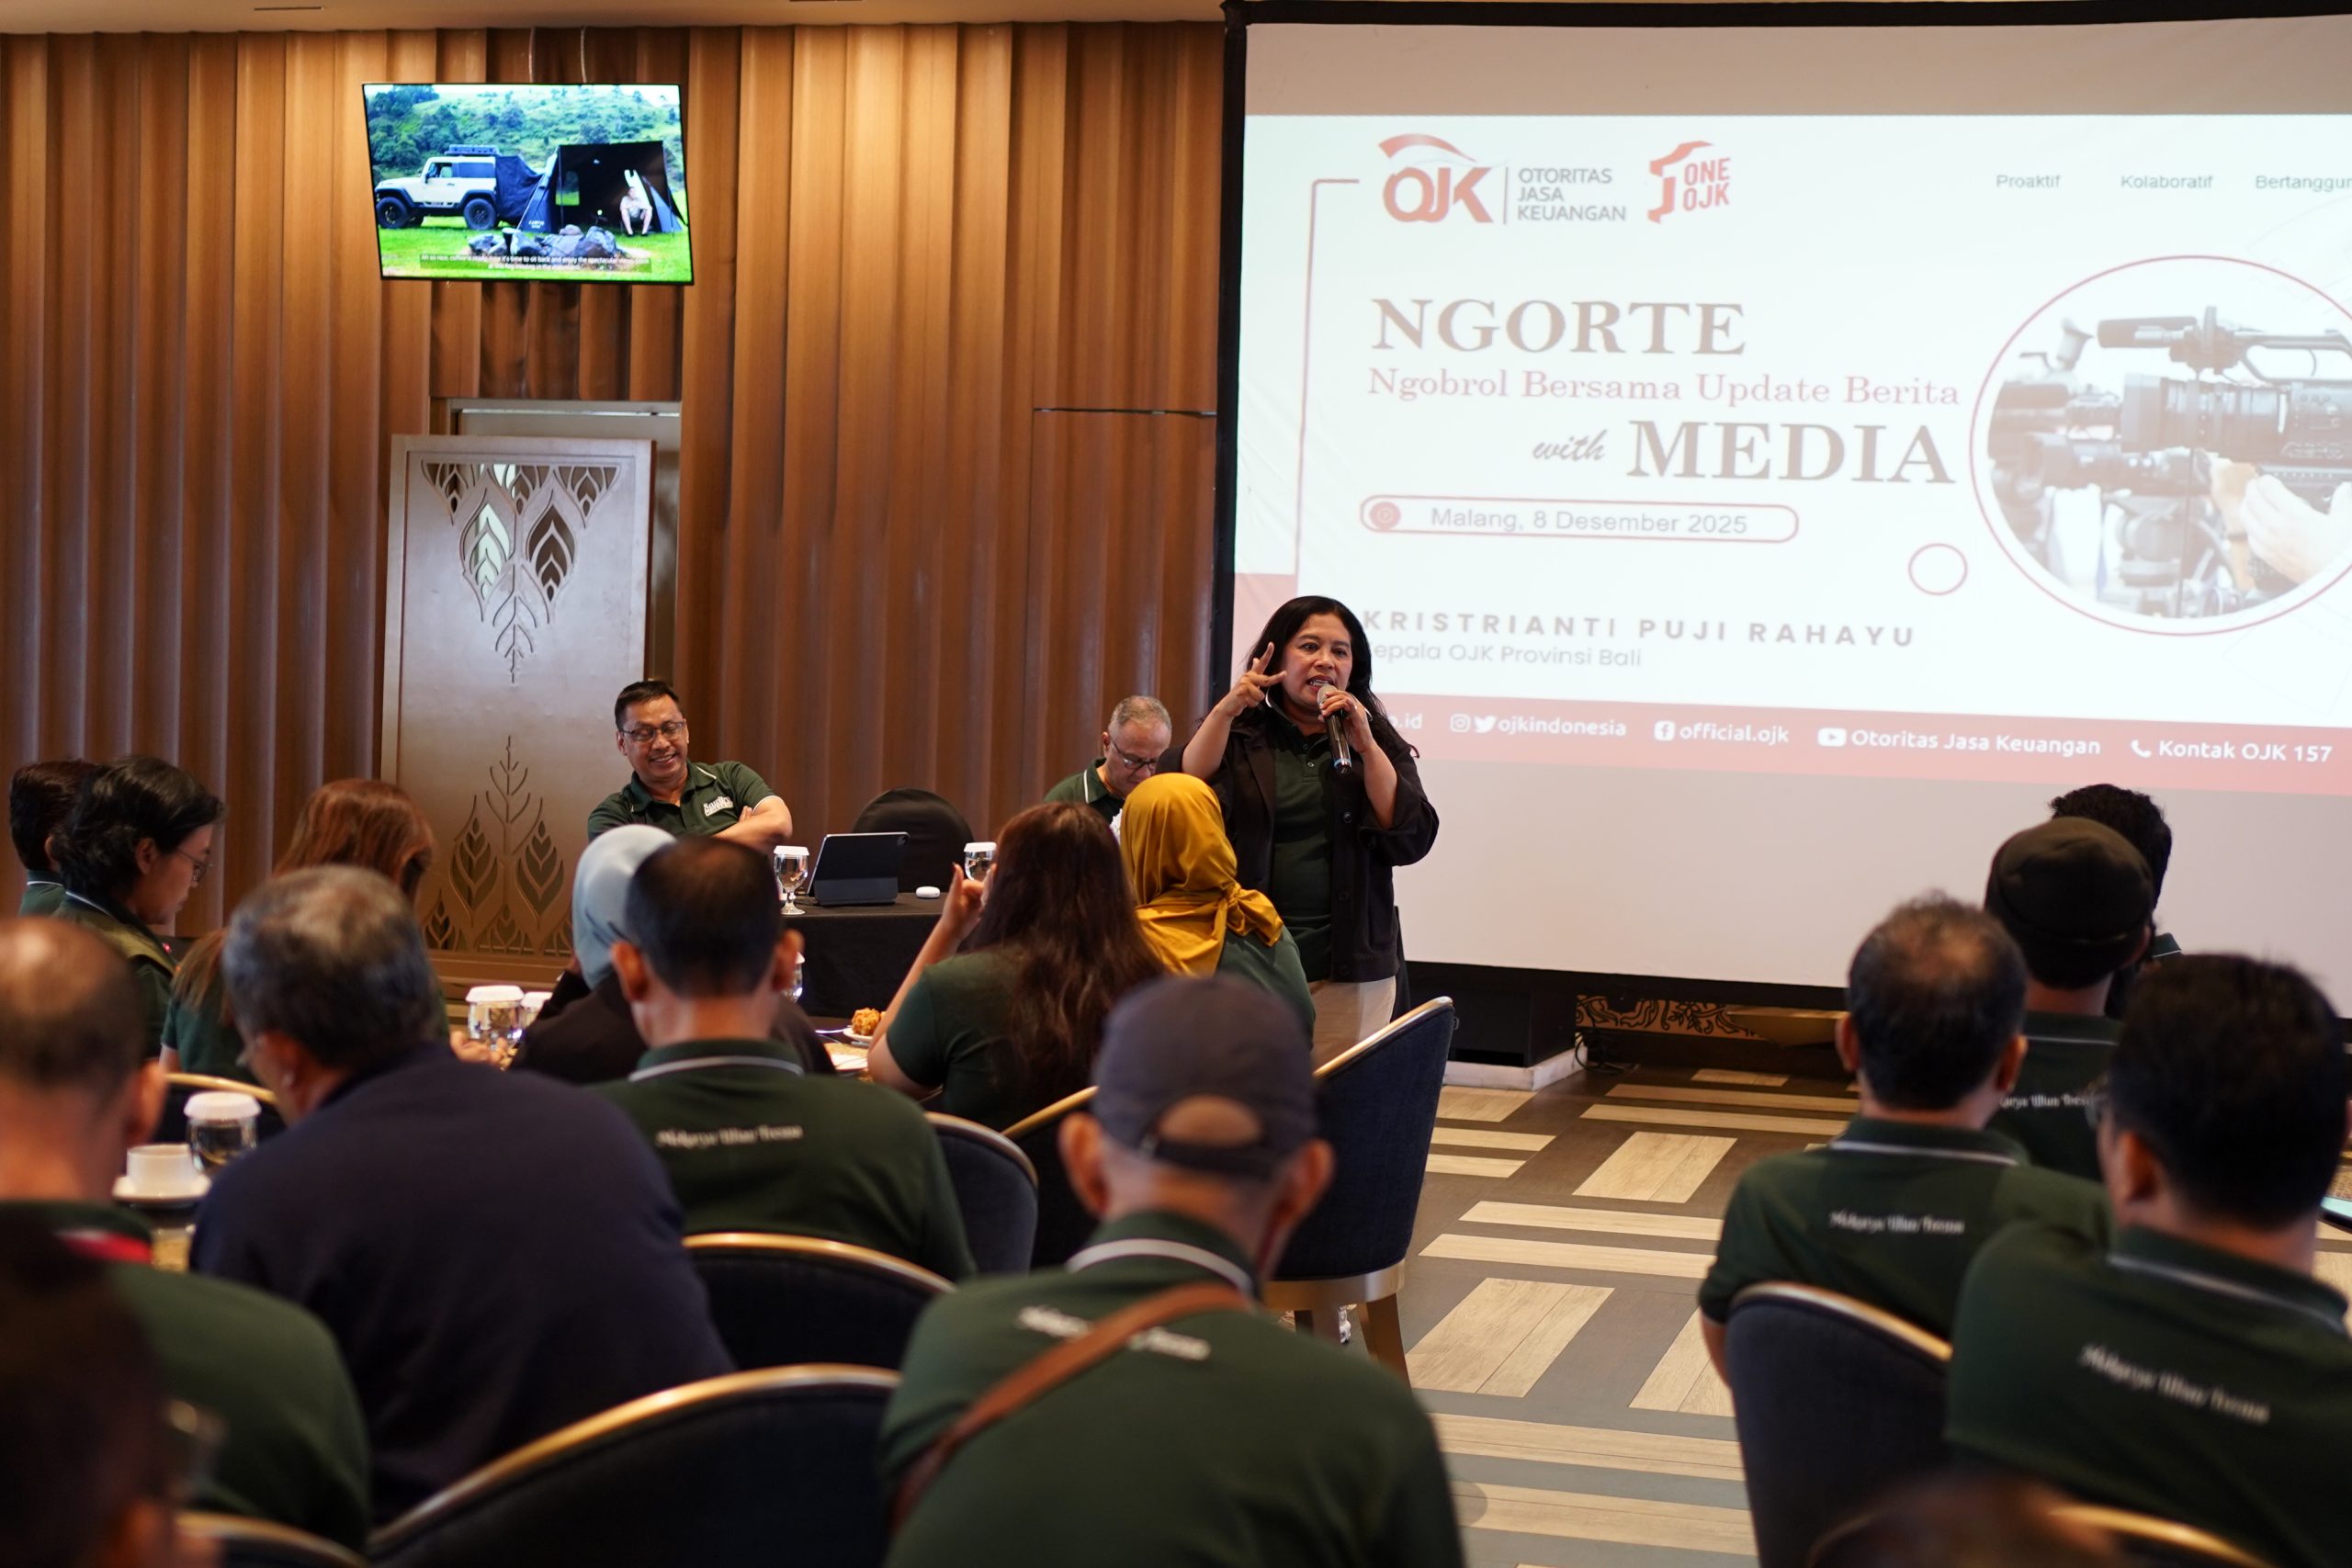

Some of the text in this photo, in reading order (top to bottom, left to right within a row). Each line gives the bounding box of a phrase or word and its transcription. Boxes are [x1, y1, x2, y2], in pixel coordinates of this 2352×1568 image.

[1518, 168, 1612, 185] OTORITAS
[1684, 157, 1731, 186] ONE
[1996, 175, 2061, 189] Proaktif
[2120, 175, 2213, 189] Kolaboratif
[1517, 186, 1565, 203] JASA
[1683, 183, 1730, 212] OJK
[1518, 205, 1627, 221] KEUANGAN
[1371, 299, 1747, 355] NGORTE
[1367, 367, 1960, 407] Ngobrol Bersama Update Berita
[1532, 420, 1956, 484] with MEDIA
[1430, 508, 1747, 535] Malang, 8 Desember 2025
[1363, 610, 1914, 648] KRISTRIANTI PUJI RAHAYU
[1369, 642, 1643, 667] epala OJK Provinsi Bali
[1498, 714, 1627, 736] ojkindonesia
[1679, 723, 1790, 746] official.ojk
[1850, 729, 2101, 759] Otoritas Jasa Keuangan
[2159, 739, 2334, 763] Kontak OJK 157
